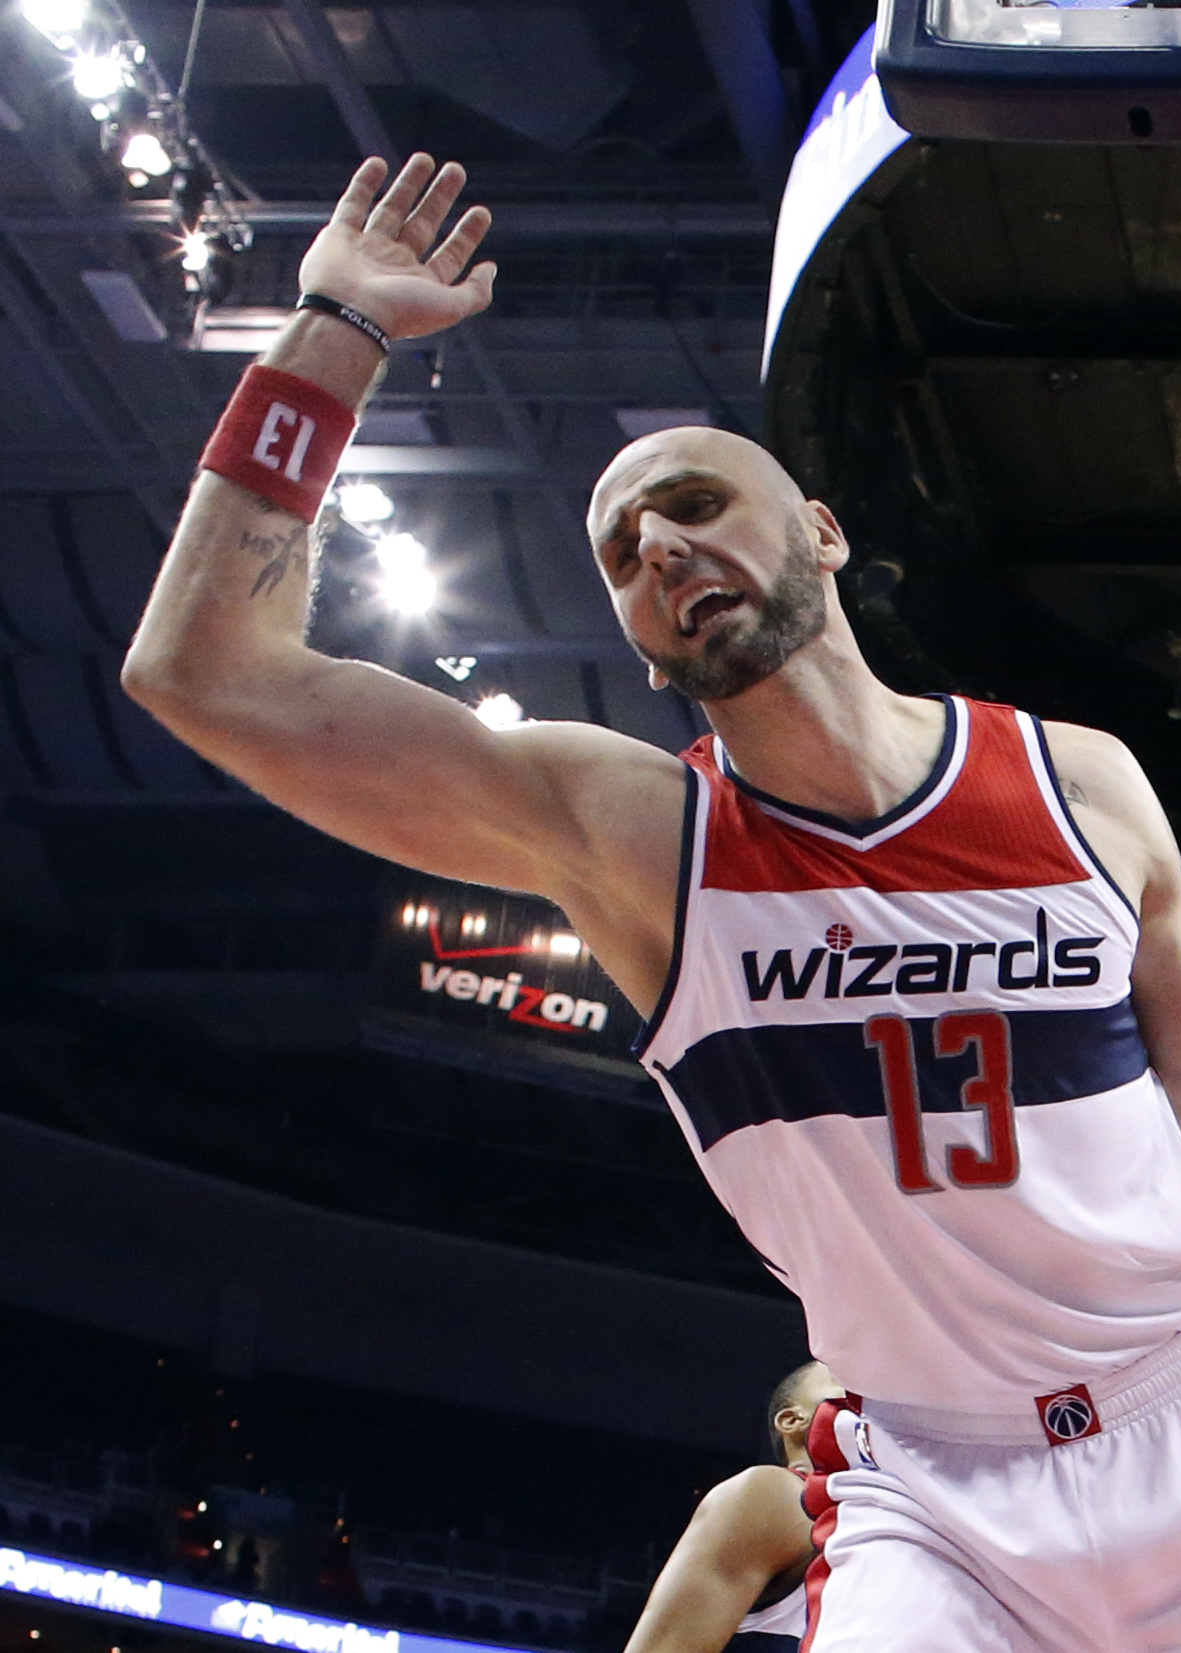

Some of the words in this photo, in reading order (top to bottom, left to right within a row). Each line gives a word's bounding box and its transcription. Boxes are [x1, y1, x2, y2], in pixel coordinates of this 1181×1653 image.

[340, 307, 382, 340] POLISH
[252, 401, 317, 483] 13
[742, 906, 1105, 1001] wizards
[419, 961, 609, 1033] verizon
[863, 1008, 1020, 1194] 13
